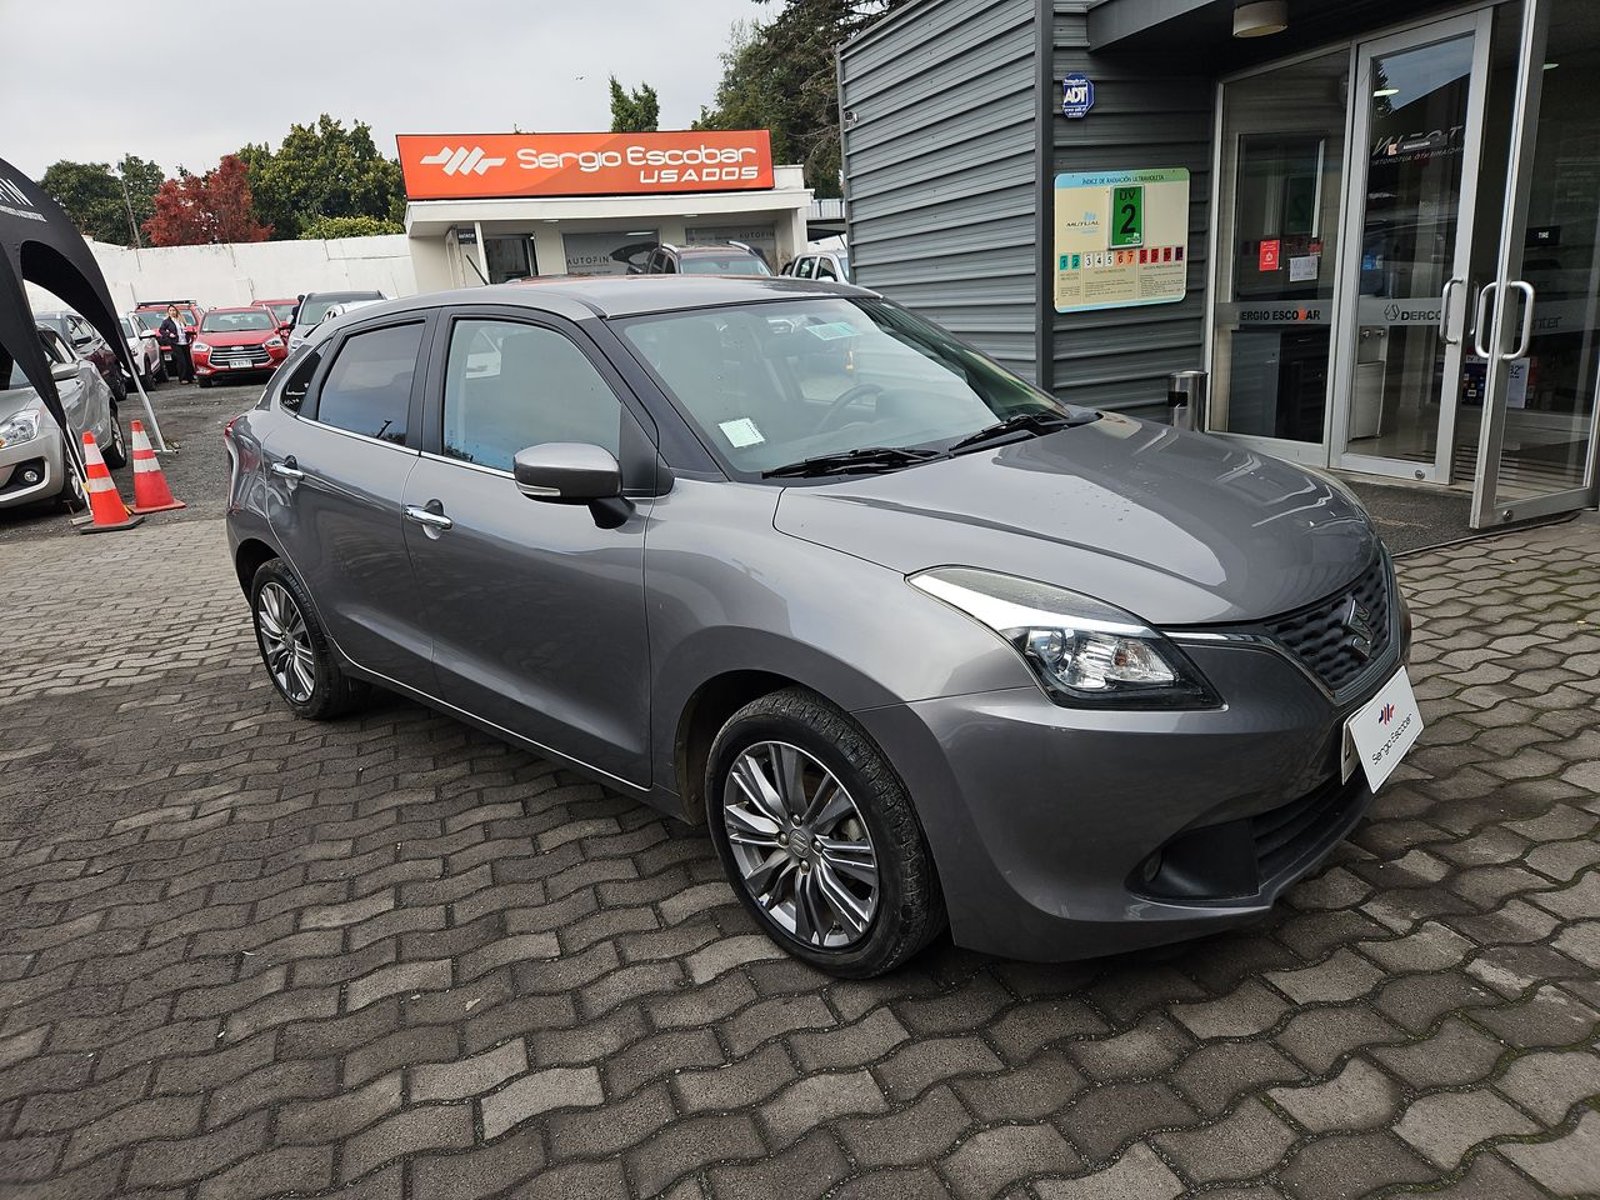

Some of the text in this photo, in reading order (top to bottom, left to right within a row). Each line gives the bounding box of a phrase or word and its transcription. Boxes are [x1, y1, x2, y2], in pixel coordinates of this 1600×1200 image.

[1064, 87, 1087, 103] ADT
[517, 145, 756, 172] Sergio Escobar
[640, 166, 759, 184] USADOS
[1120, 190, 1136, 201] UV
[1120, 204, 1136, 234] 2
[568, 256, 610, 265] AUTOFIN
[1273, 309, 1321, 321] ESCOAR
[1372, 713, 1412, 765] Sergio Escobar
